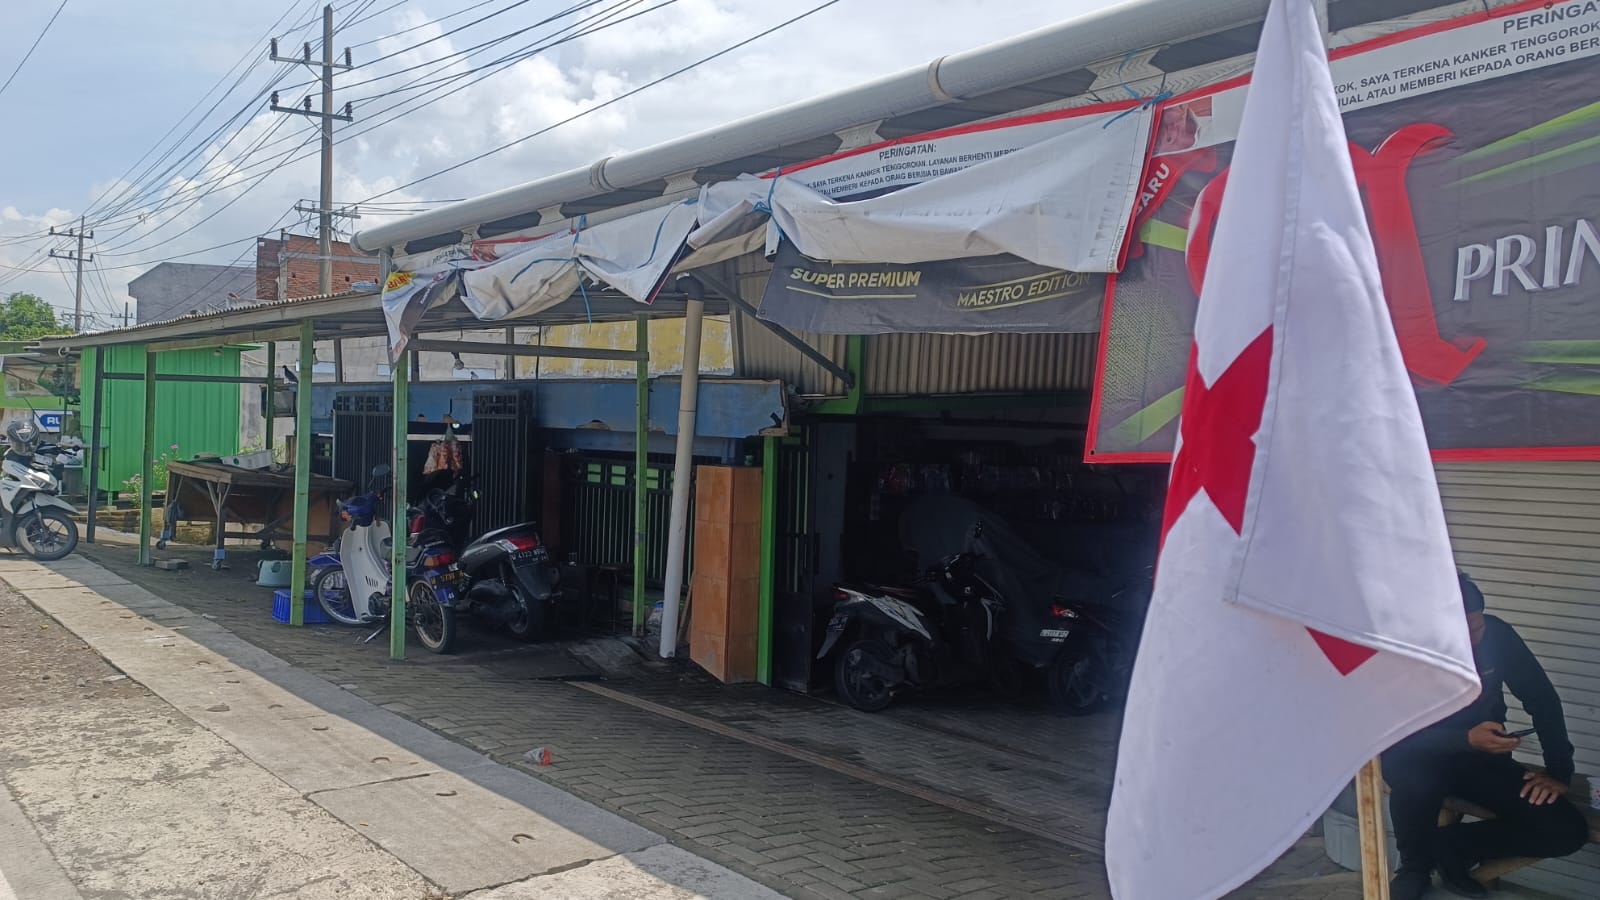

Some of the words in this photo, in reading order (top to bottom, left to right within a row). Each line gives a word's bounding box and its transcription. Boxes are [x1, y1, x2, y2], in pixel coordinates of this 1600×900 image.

[1503, 0, 1600, 34] PERINGA
[1360, 73, 1391, 89] SAYA
[1393, 58, 1451, 80] TERKENA
[1453, 43, 1507, 66] KANKER
[1510, 20, 1600, 51] TENGGOROK
[1366, 84, 1397, 101] ATAU
[1399, 70, 1457, 93] MEMBERI
[1459, 57, 1512, 78] KEPADA
[1515, 45, 1566, 65] ORANG
[827, 174, 855, 185] TERKENA
[928, 154, 958, 168] LAYANAN
[958, 149, 993, 163] BERHENTI
[879, 143, 937, 160] PERINGATAN:
[859, 177, 883, 188] KEPADA
[884, 172, 906, 182] ORANG
[932, 168, 939, 177] DI
[790, 267, 845, 289] SUPER
[848, 271, 921, 288] PREMIUM
[957, 284, 1024, 307] MAESTRO
[1027, 270, 1090, 297] EDITION
